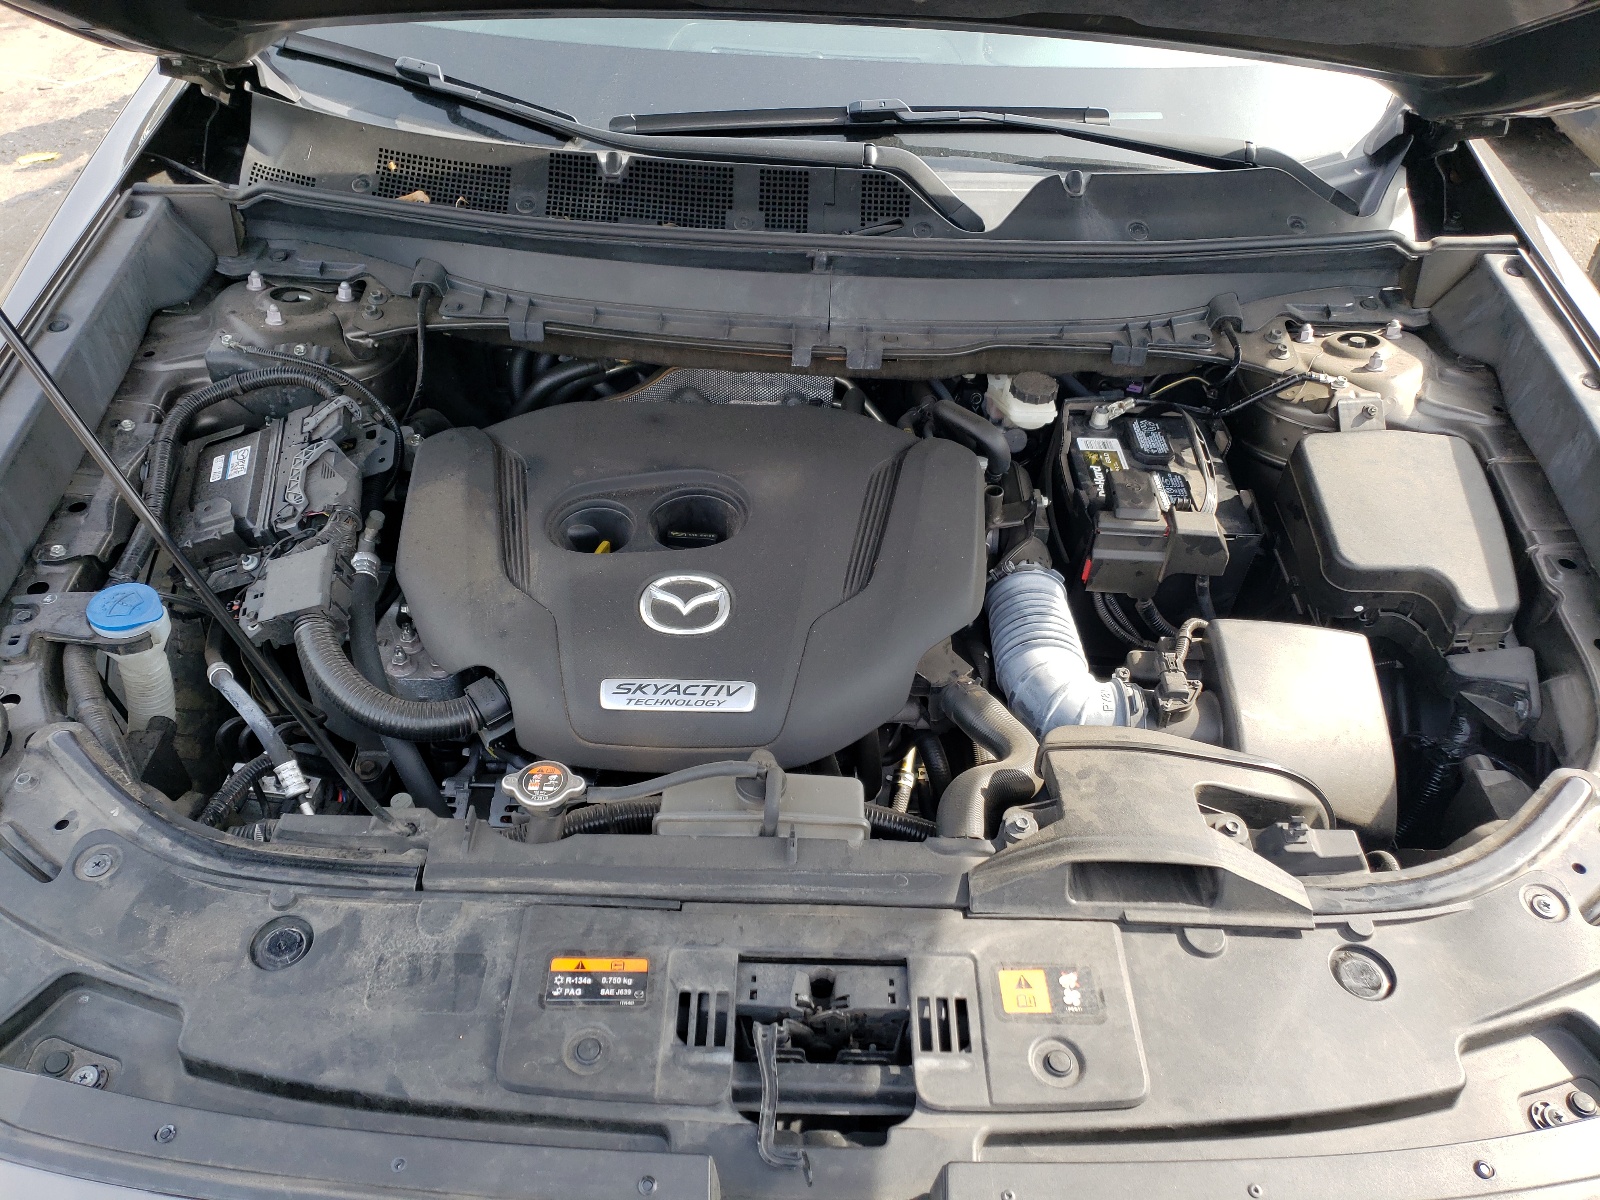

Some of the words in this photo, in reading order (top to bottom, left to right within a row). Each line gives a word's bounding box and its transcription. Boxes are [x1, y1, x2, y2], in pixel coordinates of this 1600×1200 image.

[612, 683, 745, 697] SKYACTIV
[625, 698, 727, 707] TECHNOLOGY
[565, 976, 592, 985] R-134a
[622, 976, 633, 986] kg
[564, 988, 582, 996] PAG
[600, 988, 615, 996] SAE
